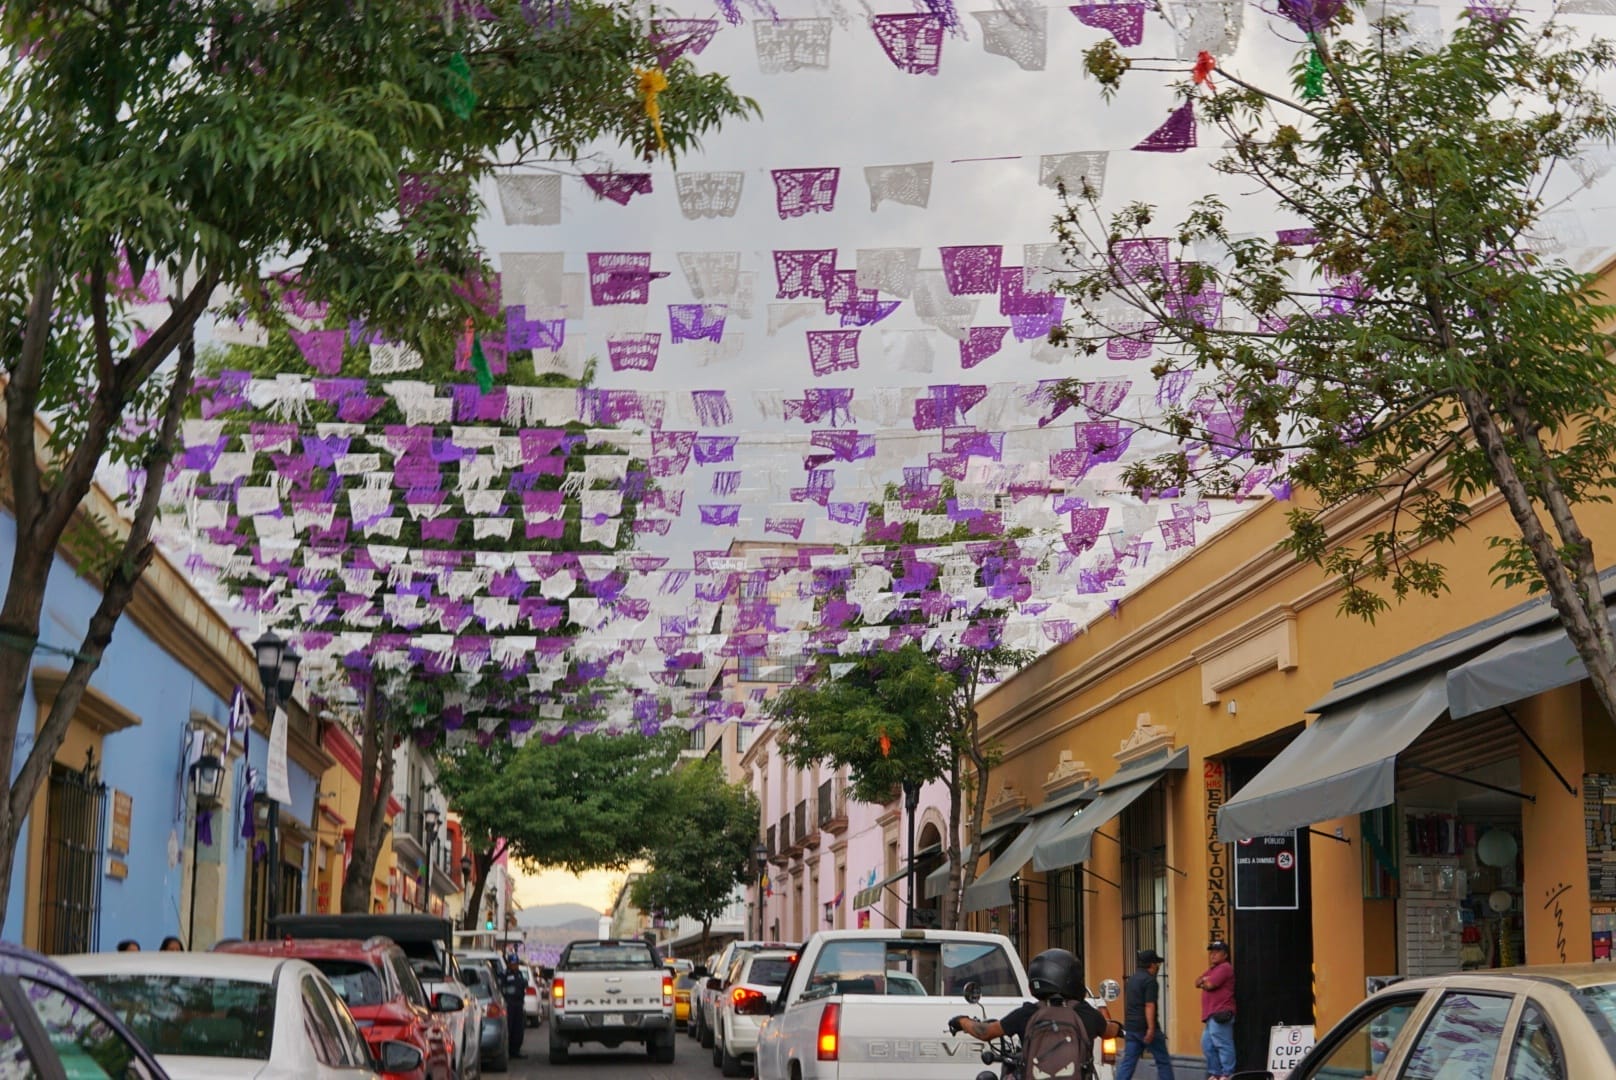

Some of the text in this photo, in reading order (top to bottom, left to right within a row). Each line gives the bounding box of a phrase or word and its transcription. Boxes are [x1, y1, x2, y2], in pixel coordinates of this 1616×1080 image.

[1204, 762, 1223, 778] 24
[1280, 854, 1290, 863] 24
[1292, 1032, 1298, 1041] E
[1272, 1060, 1300, 1069] LLE
